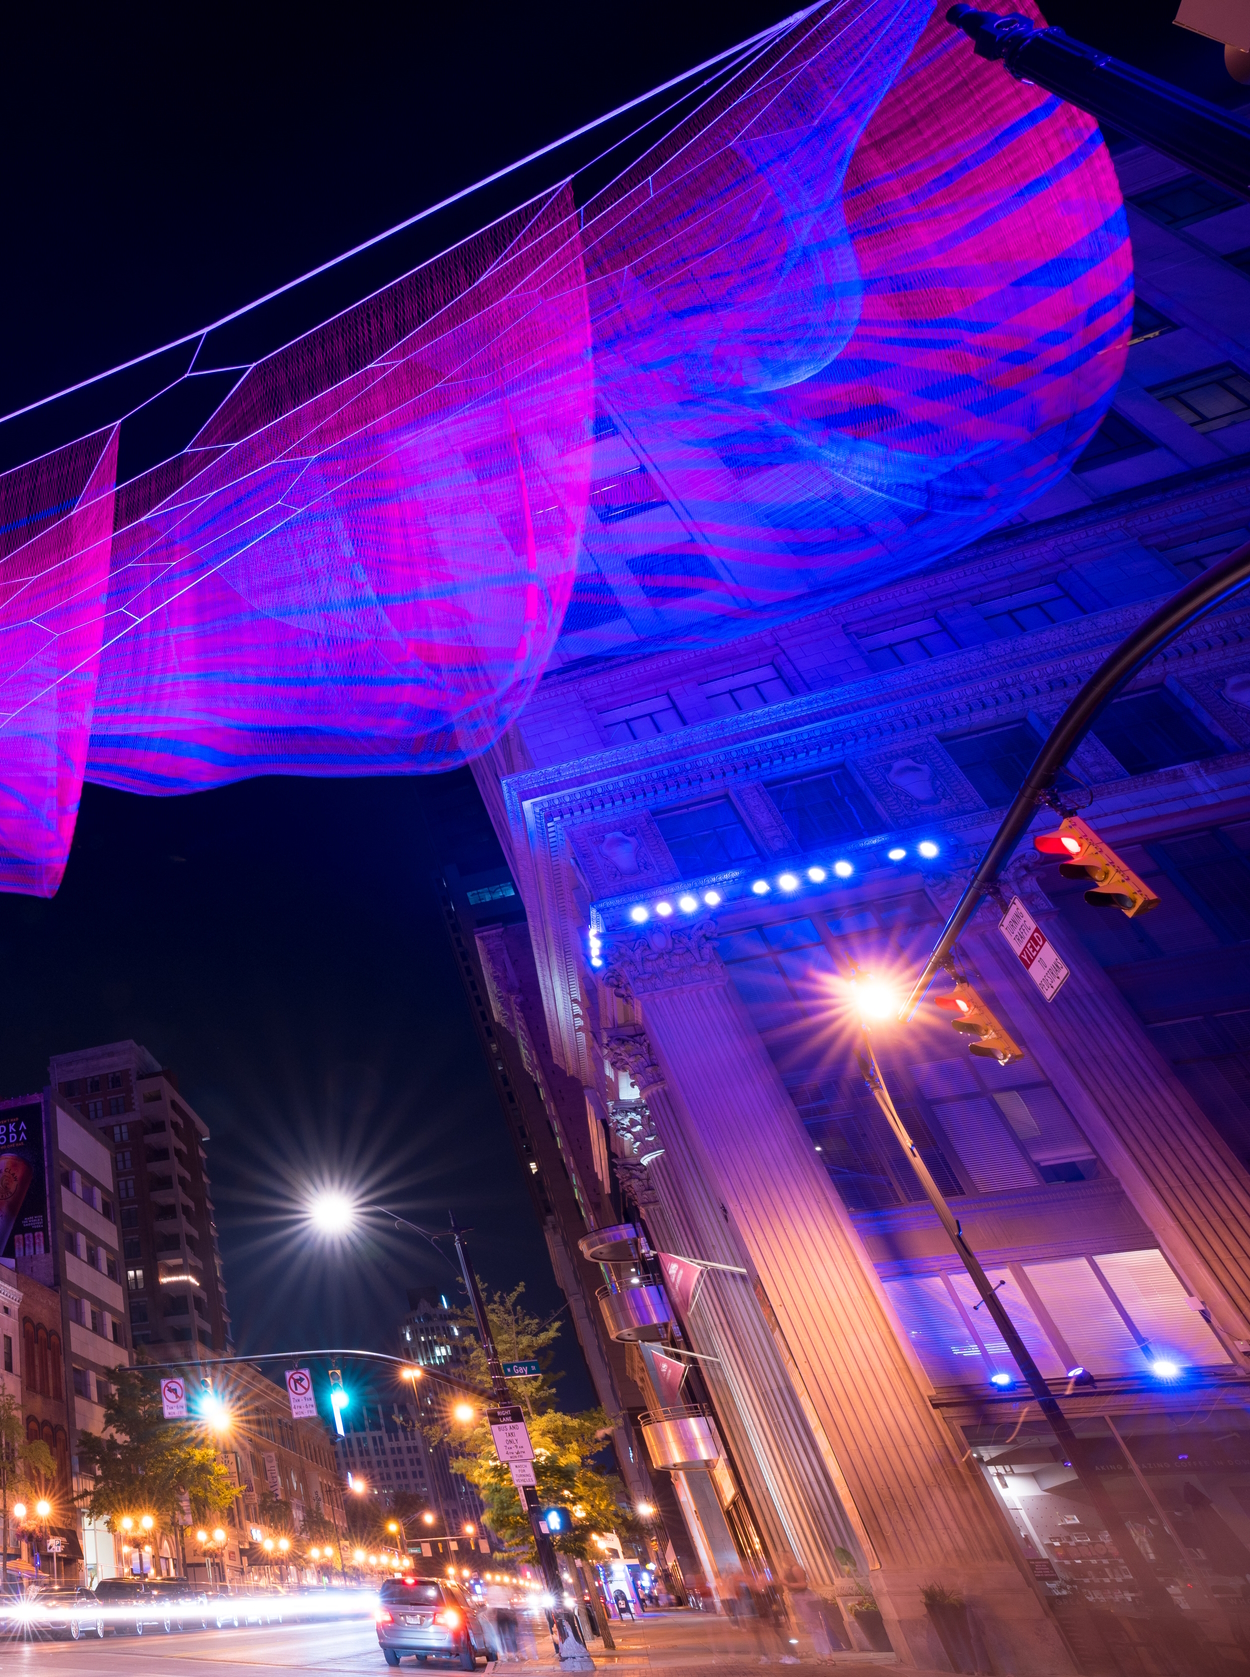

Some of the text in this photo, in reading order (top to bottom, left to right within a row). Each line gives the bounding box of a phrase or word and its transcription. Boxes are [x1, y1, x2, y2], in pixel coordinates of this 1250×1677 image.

[1005, 908, 1024, 936] TURNING
[1014, 920, 1031, 947] TRAFFIC
[1021, 932, 1043, 964] YIELD
[1037, 957, 1047, 970] TO
[1039, 958, 1064, 994] PEDESTRIANS
[4, 1167, 18, 1182] CLAW
[513, 1365, 528, 1375] Gay
[1093, 1464, 1123, 1472] AKING
[1174, 1460, 1210, 1468] COFFEE
